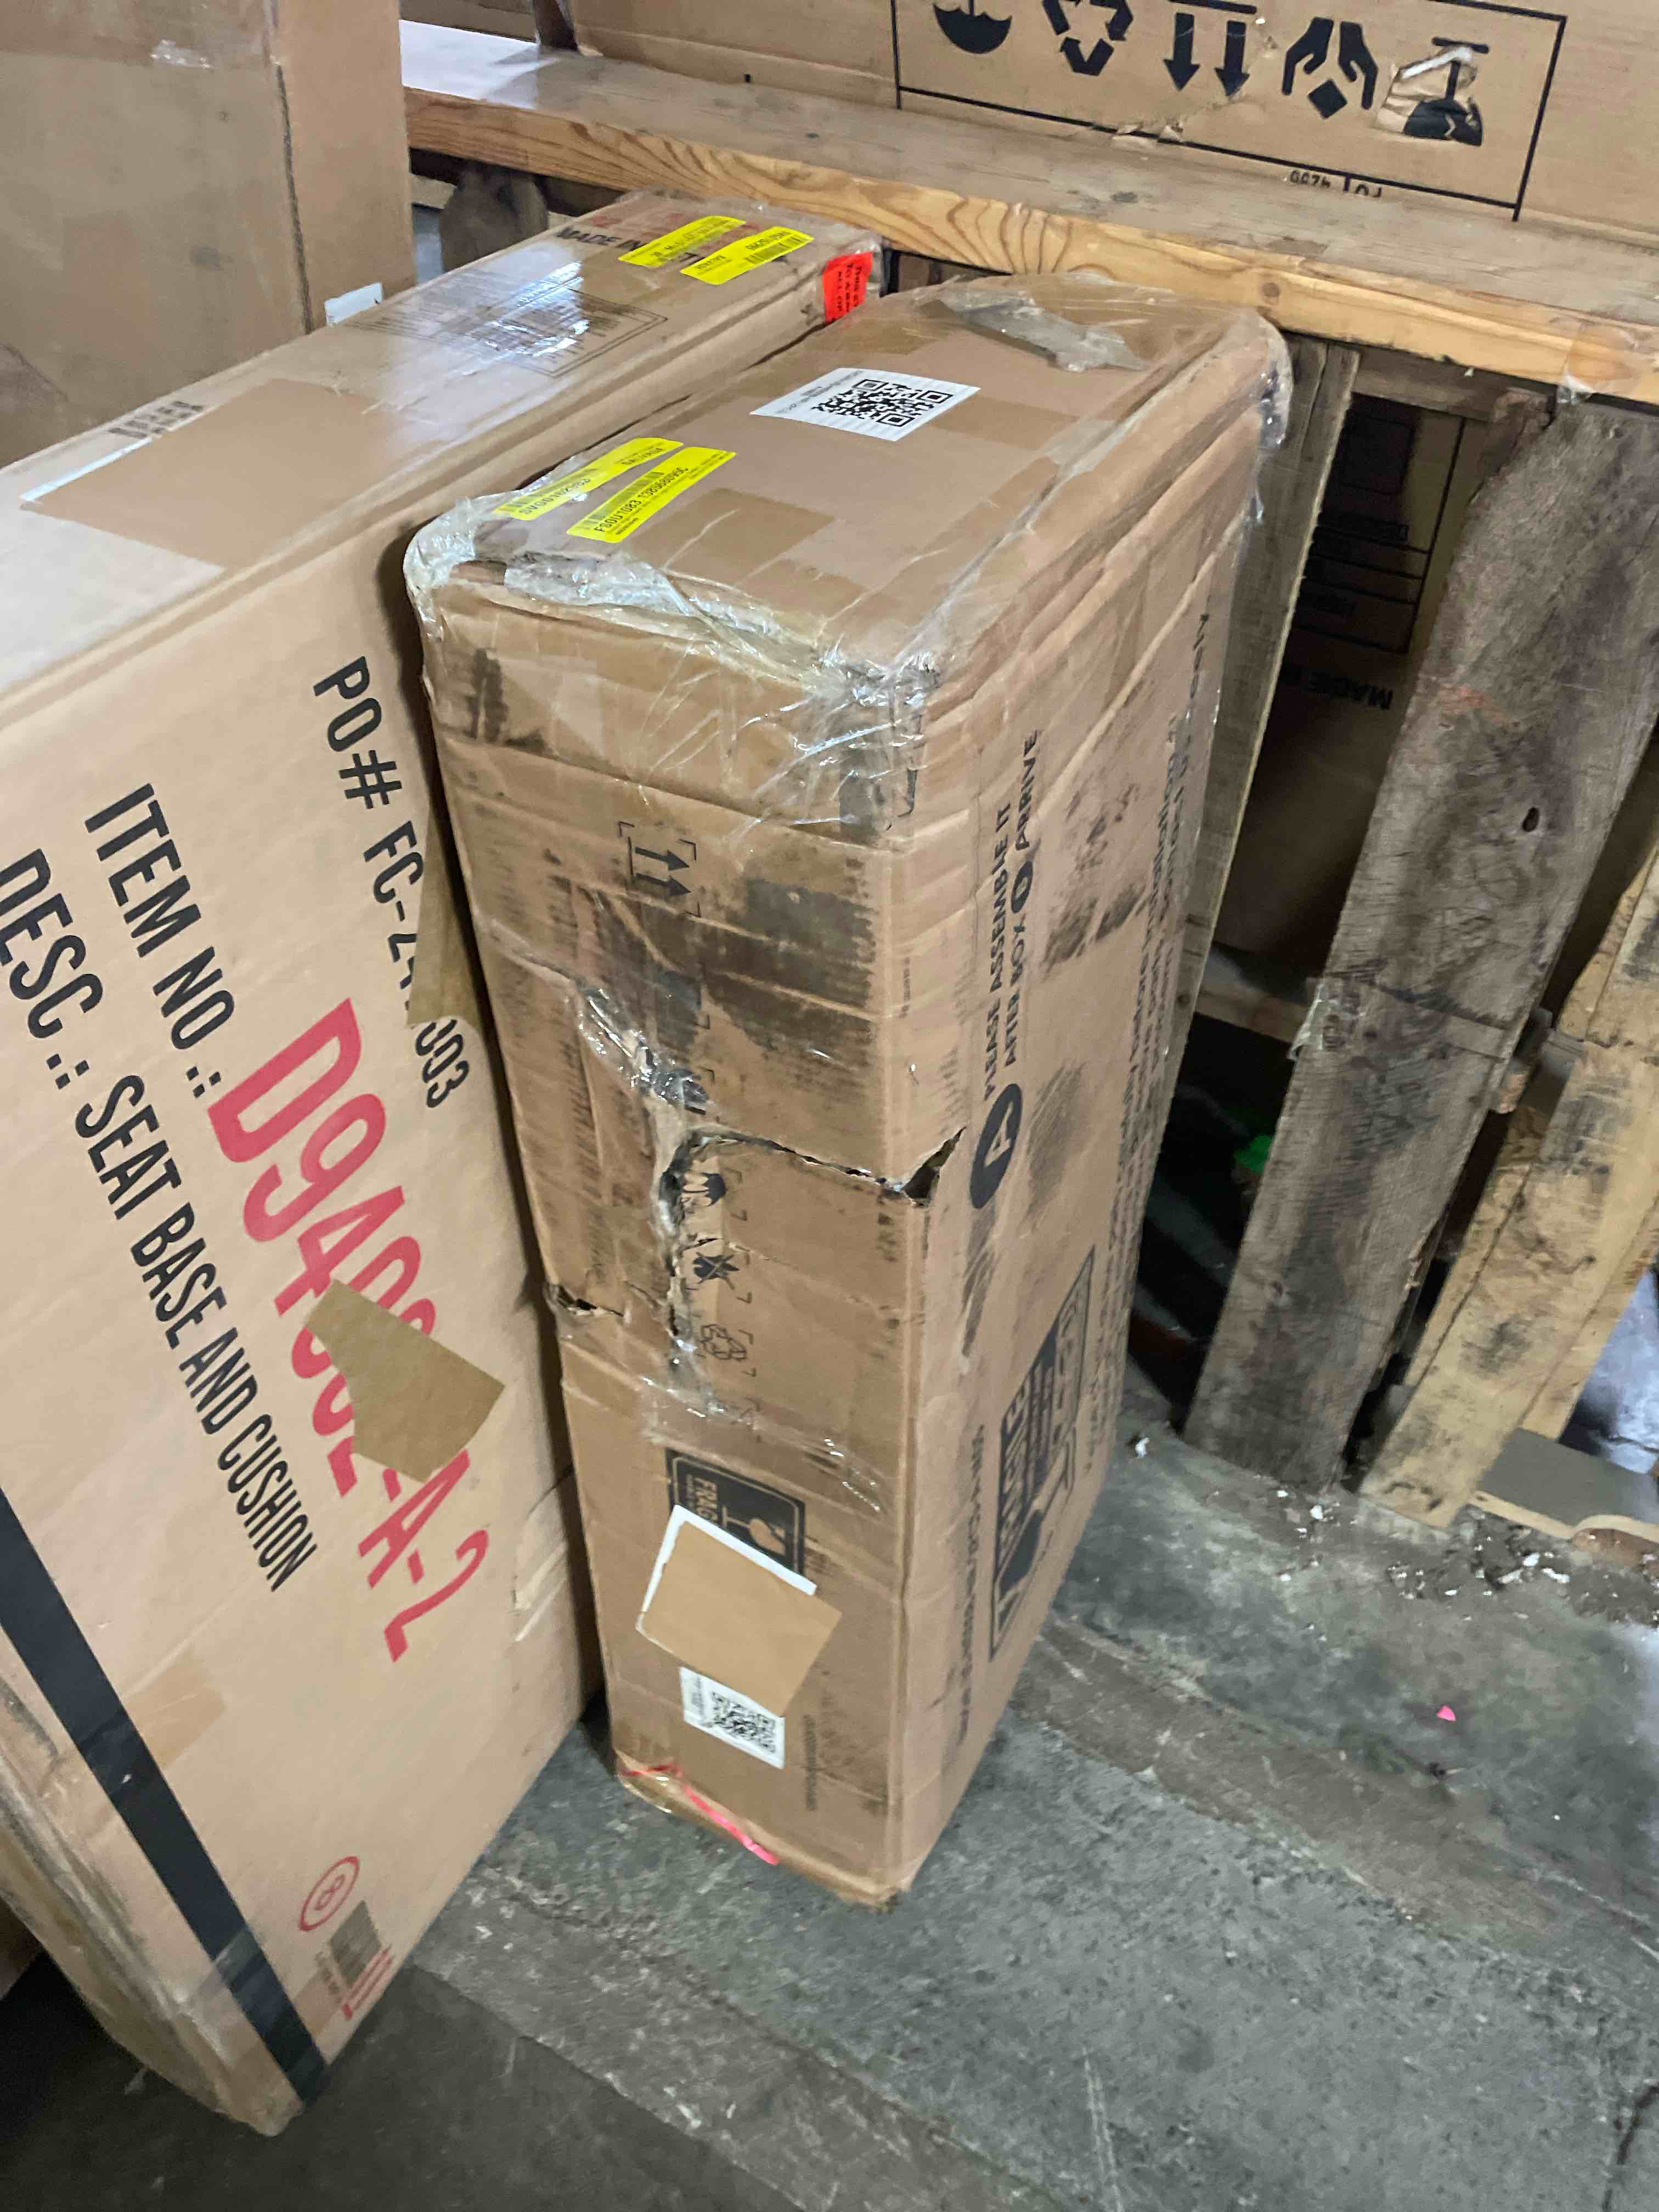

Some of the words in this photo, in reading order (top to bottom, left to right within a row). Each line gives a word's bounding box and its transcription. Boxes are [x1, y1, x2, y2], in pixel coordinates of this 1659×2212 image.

[313, 656, 402, 809] PO#
[1016, 730, 1037, 850] ARRIVE
[84, 783, 201, 958] ITEM
[996, 803, 1011, 833] IT
[990, 834, 1008, 992] ASSEMBLE
[1011, 913, 1026, 988] BOX
[984, 997, 1001, 1101] PLEASE
[1005, 989, 1020, 1068] AFTER
[75, 1075, 182, 1221] SEAT
[130, 1201, 227, 1349] BASE
[179, 1327, 258, 1435] AND
[217, 1413, 318, 1593] CUSHION
[694, 1477, 718, 1521] FRAG
